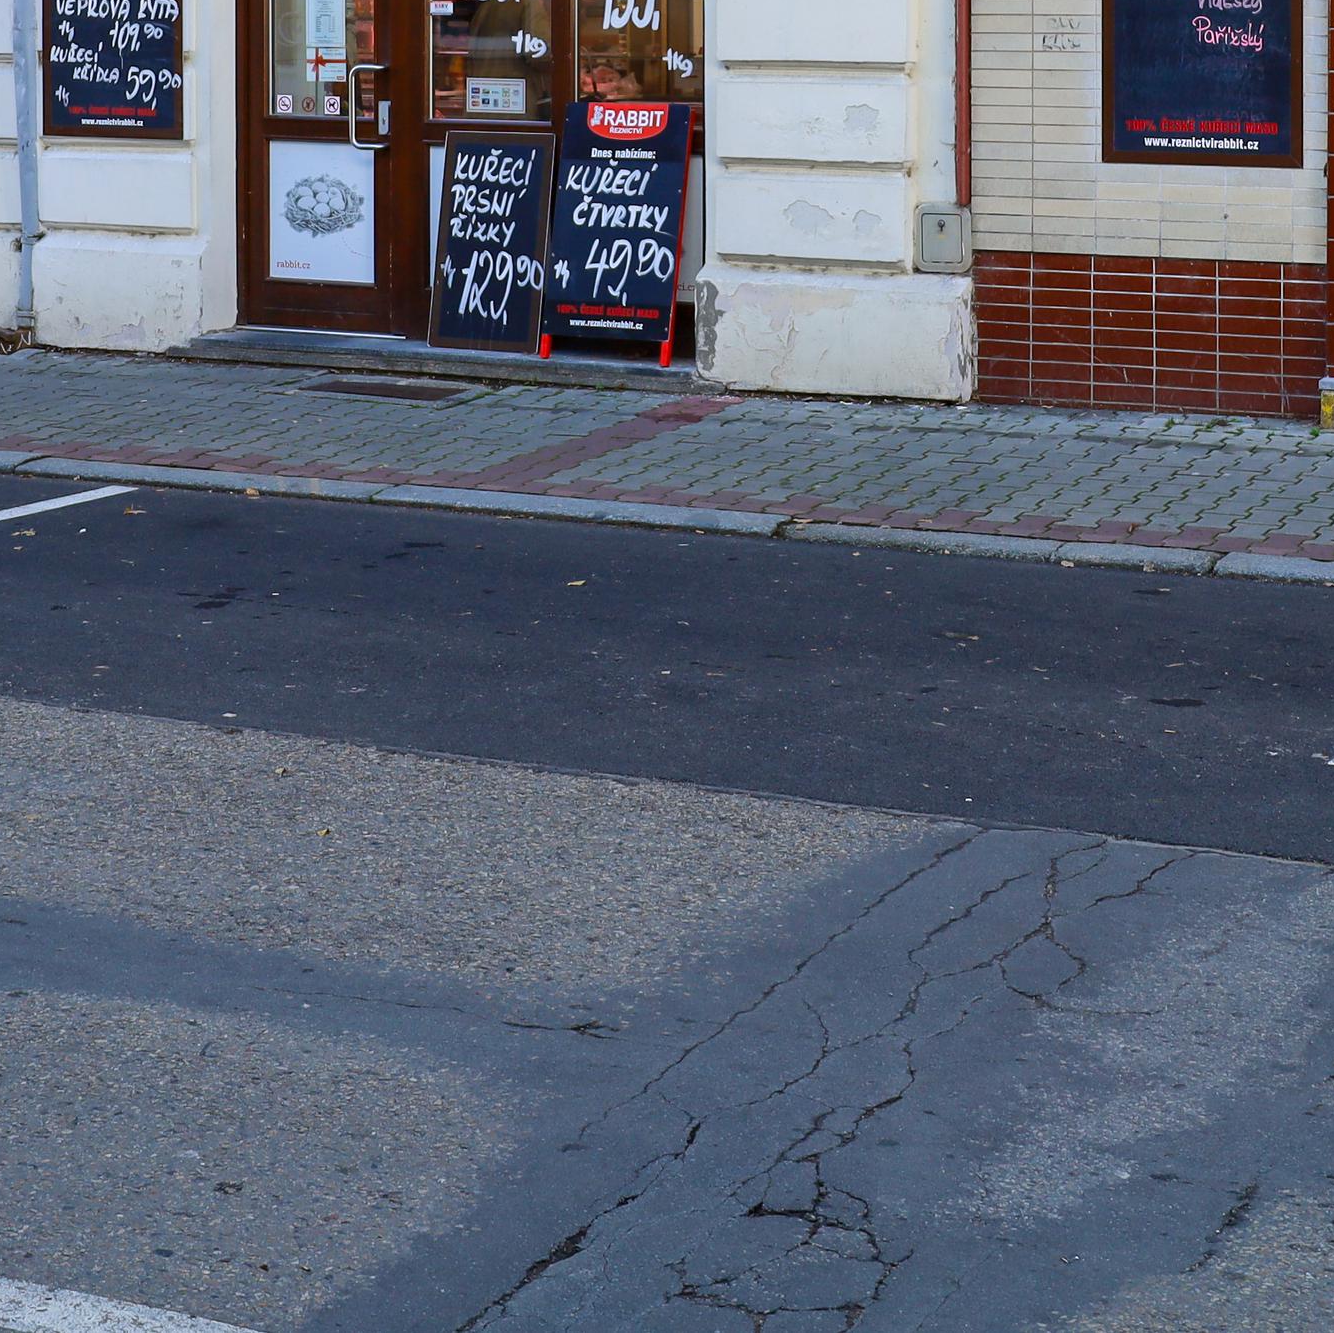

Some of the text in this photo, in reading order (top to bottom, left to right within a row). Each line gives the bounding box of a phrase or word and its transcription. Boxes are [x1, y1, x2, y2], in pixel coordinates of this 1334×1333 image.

[511, 30, 547, 58] 1kg
[1192, 15, 1264, 52] Pařížský
[50, 41, 103, 63] KUŘECÍ
[73, 64, 120, 84] KŘÍDLA
[662, 48, 693, 79] 1kg
[604, 110, 665, 128] RABBIT
[1161, 117, 1195, 132] ČESKÉ
[1245, 122, 1279, 135] MASO
[609, 127, 643, 135] ŘEZNICTVÍ
[591, 147, 656, 159] Dnes nabízíme:
[1144, 136, 1259, 150] www.reznictvirabbit.cz
[454, 148, 536, 186] KUŘECÍ
[566, 160, 658, 196] KUŘECÍ
[451, 184, 527, 217] PRSNÍ
[573, 196, 669, 232] ČTVRTKY
[450, 213, 515, 247] ŘÍZKY
[276, 260, 311, 270] rabbit.cz
[570, 318, 644, 331] www.reznictvirabbit.cz
